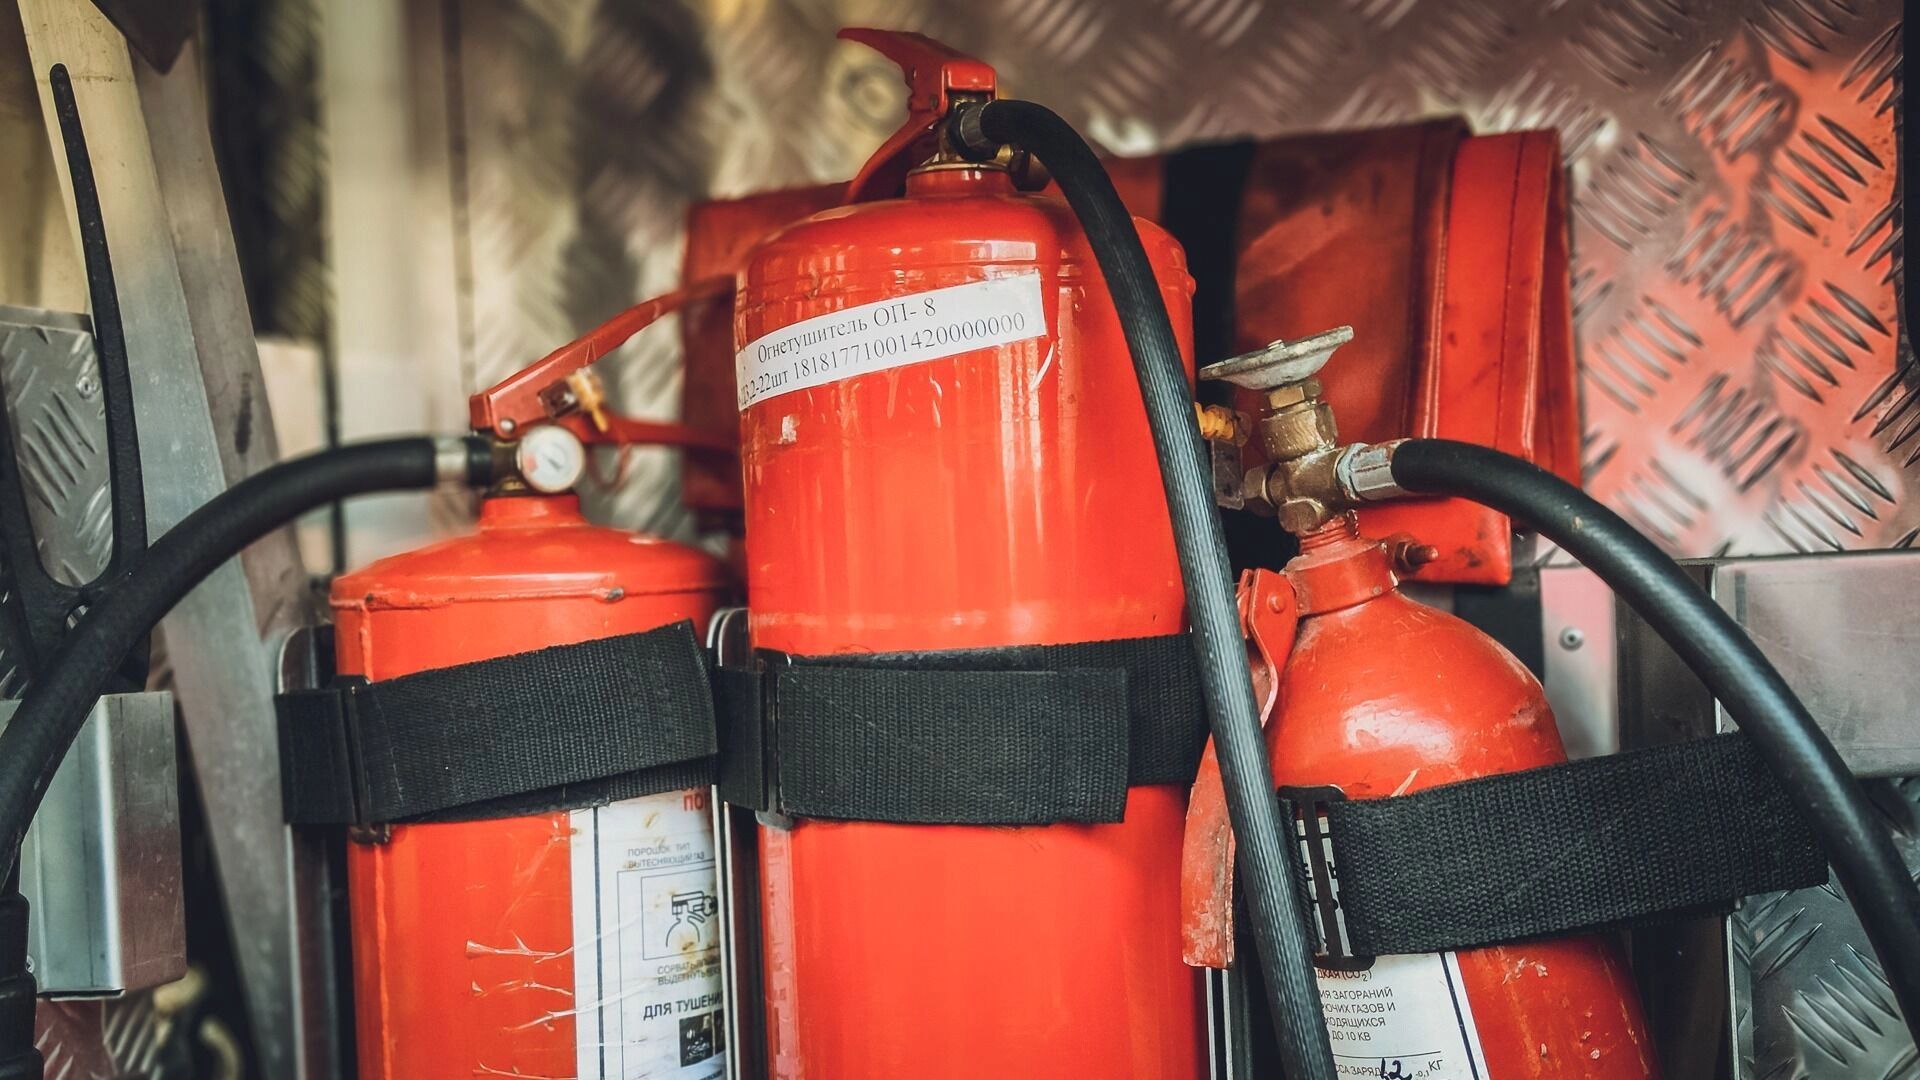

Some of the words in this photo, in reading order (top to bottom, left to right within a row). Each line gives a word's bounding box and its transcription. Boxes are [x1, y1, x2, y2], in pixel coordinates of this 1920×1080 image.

[758, 317, 868, 363] Огнетушитель
[794, 312, 1025, 379] 18181771001420000000
[628, 845, 669, 857] ПОРОШОК
[1332, 986, 1393, 1000] ЗАГОРАНИЙ
[643, 1001, 672, 1021] ДЛЯ
[1351, 1003, 1385, 1014] ГАЗОВ
[1387, 1002, 1396, 1011] И
[1332, 1030, 1344, 1041] ДО
[1346, 1031, 1356, 1041] 10
[1358, 1032, 1371, 1041] КВ
[1428, 1059, 1444, 1072] КГ
